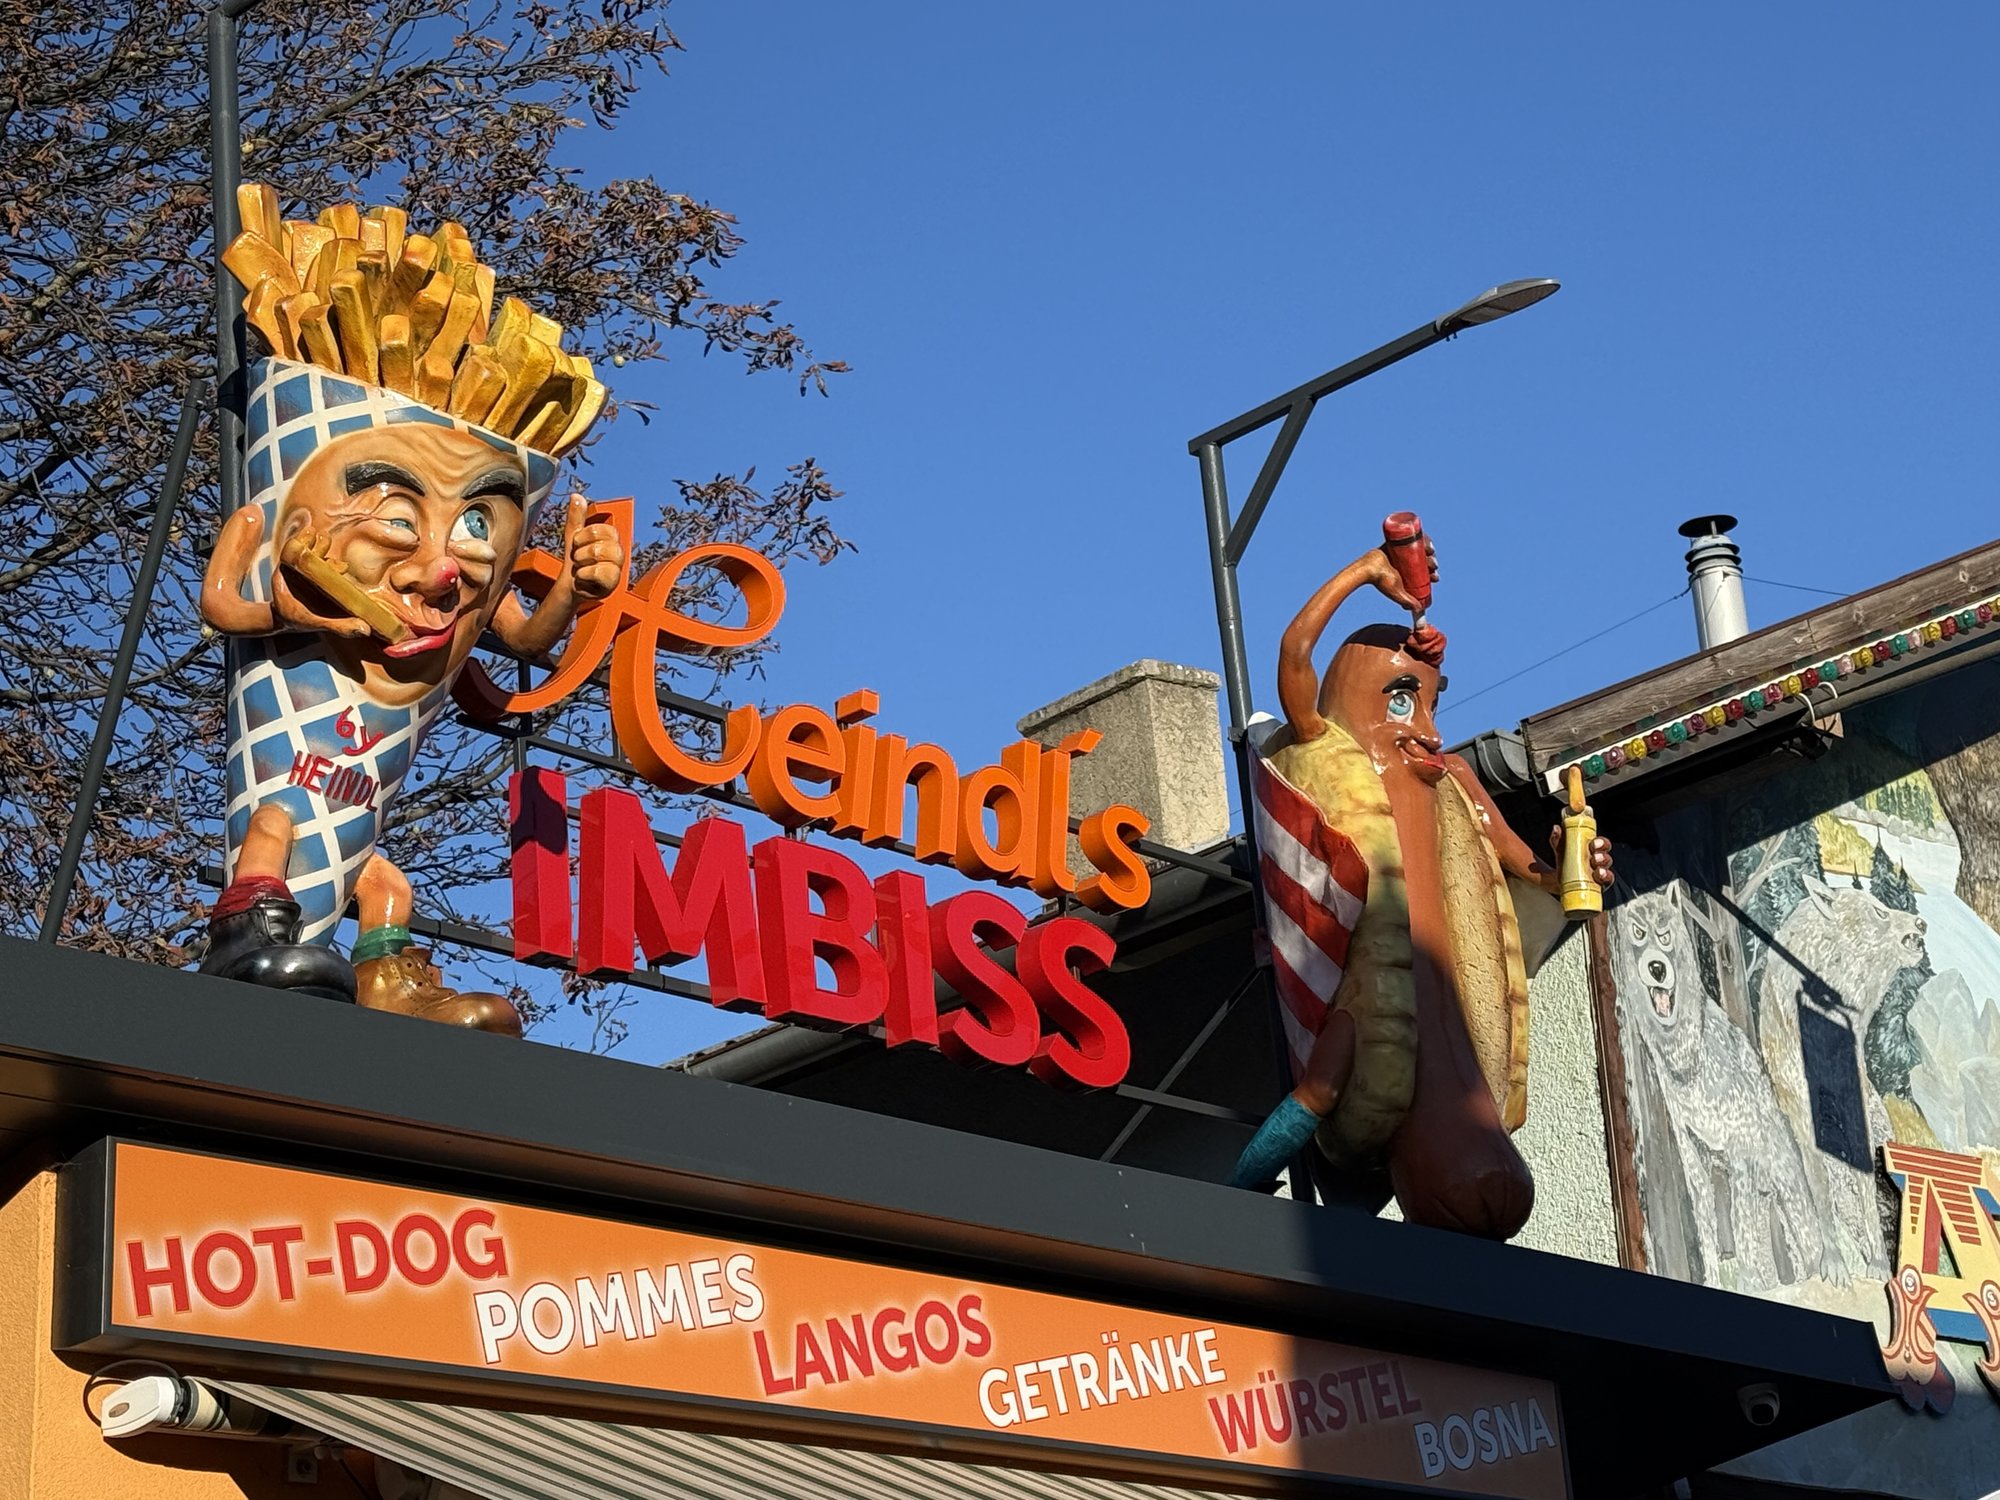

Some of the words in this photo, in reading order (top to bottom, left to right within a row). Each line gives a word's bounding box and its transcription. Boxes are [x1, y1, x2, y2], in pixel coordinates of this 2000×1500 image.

[287, 750, 380, 812] HEINDL
[509, 766, 1132, 1089] IMBISS
[126, 1208, 509, 1318] HOT-DOG
[474, 1253, 765, 1364] POMMES
[753, 1294, 992, 1396] LANGOS
[978, 1327, 1227, 1428] GETRÄNKE
[1207, 1360, 1423, 1454] WÜRSTEL
[1413, 1397, 1556, 1480] BOSNA
